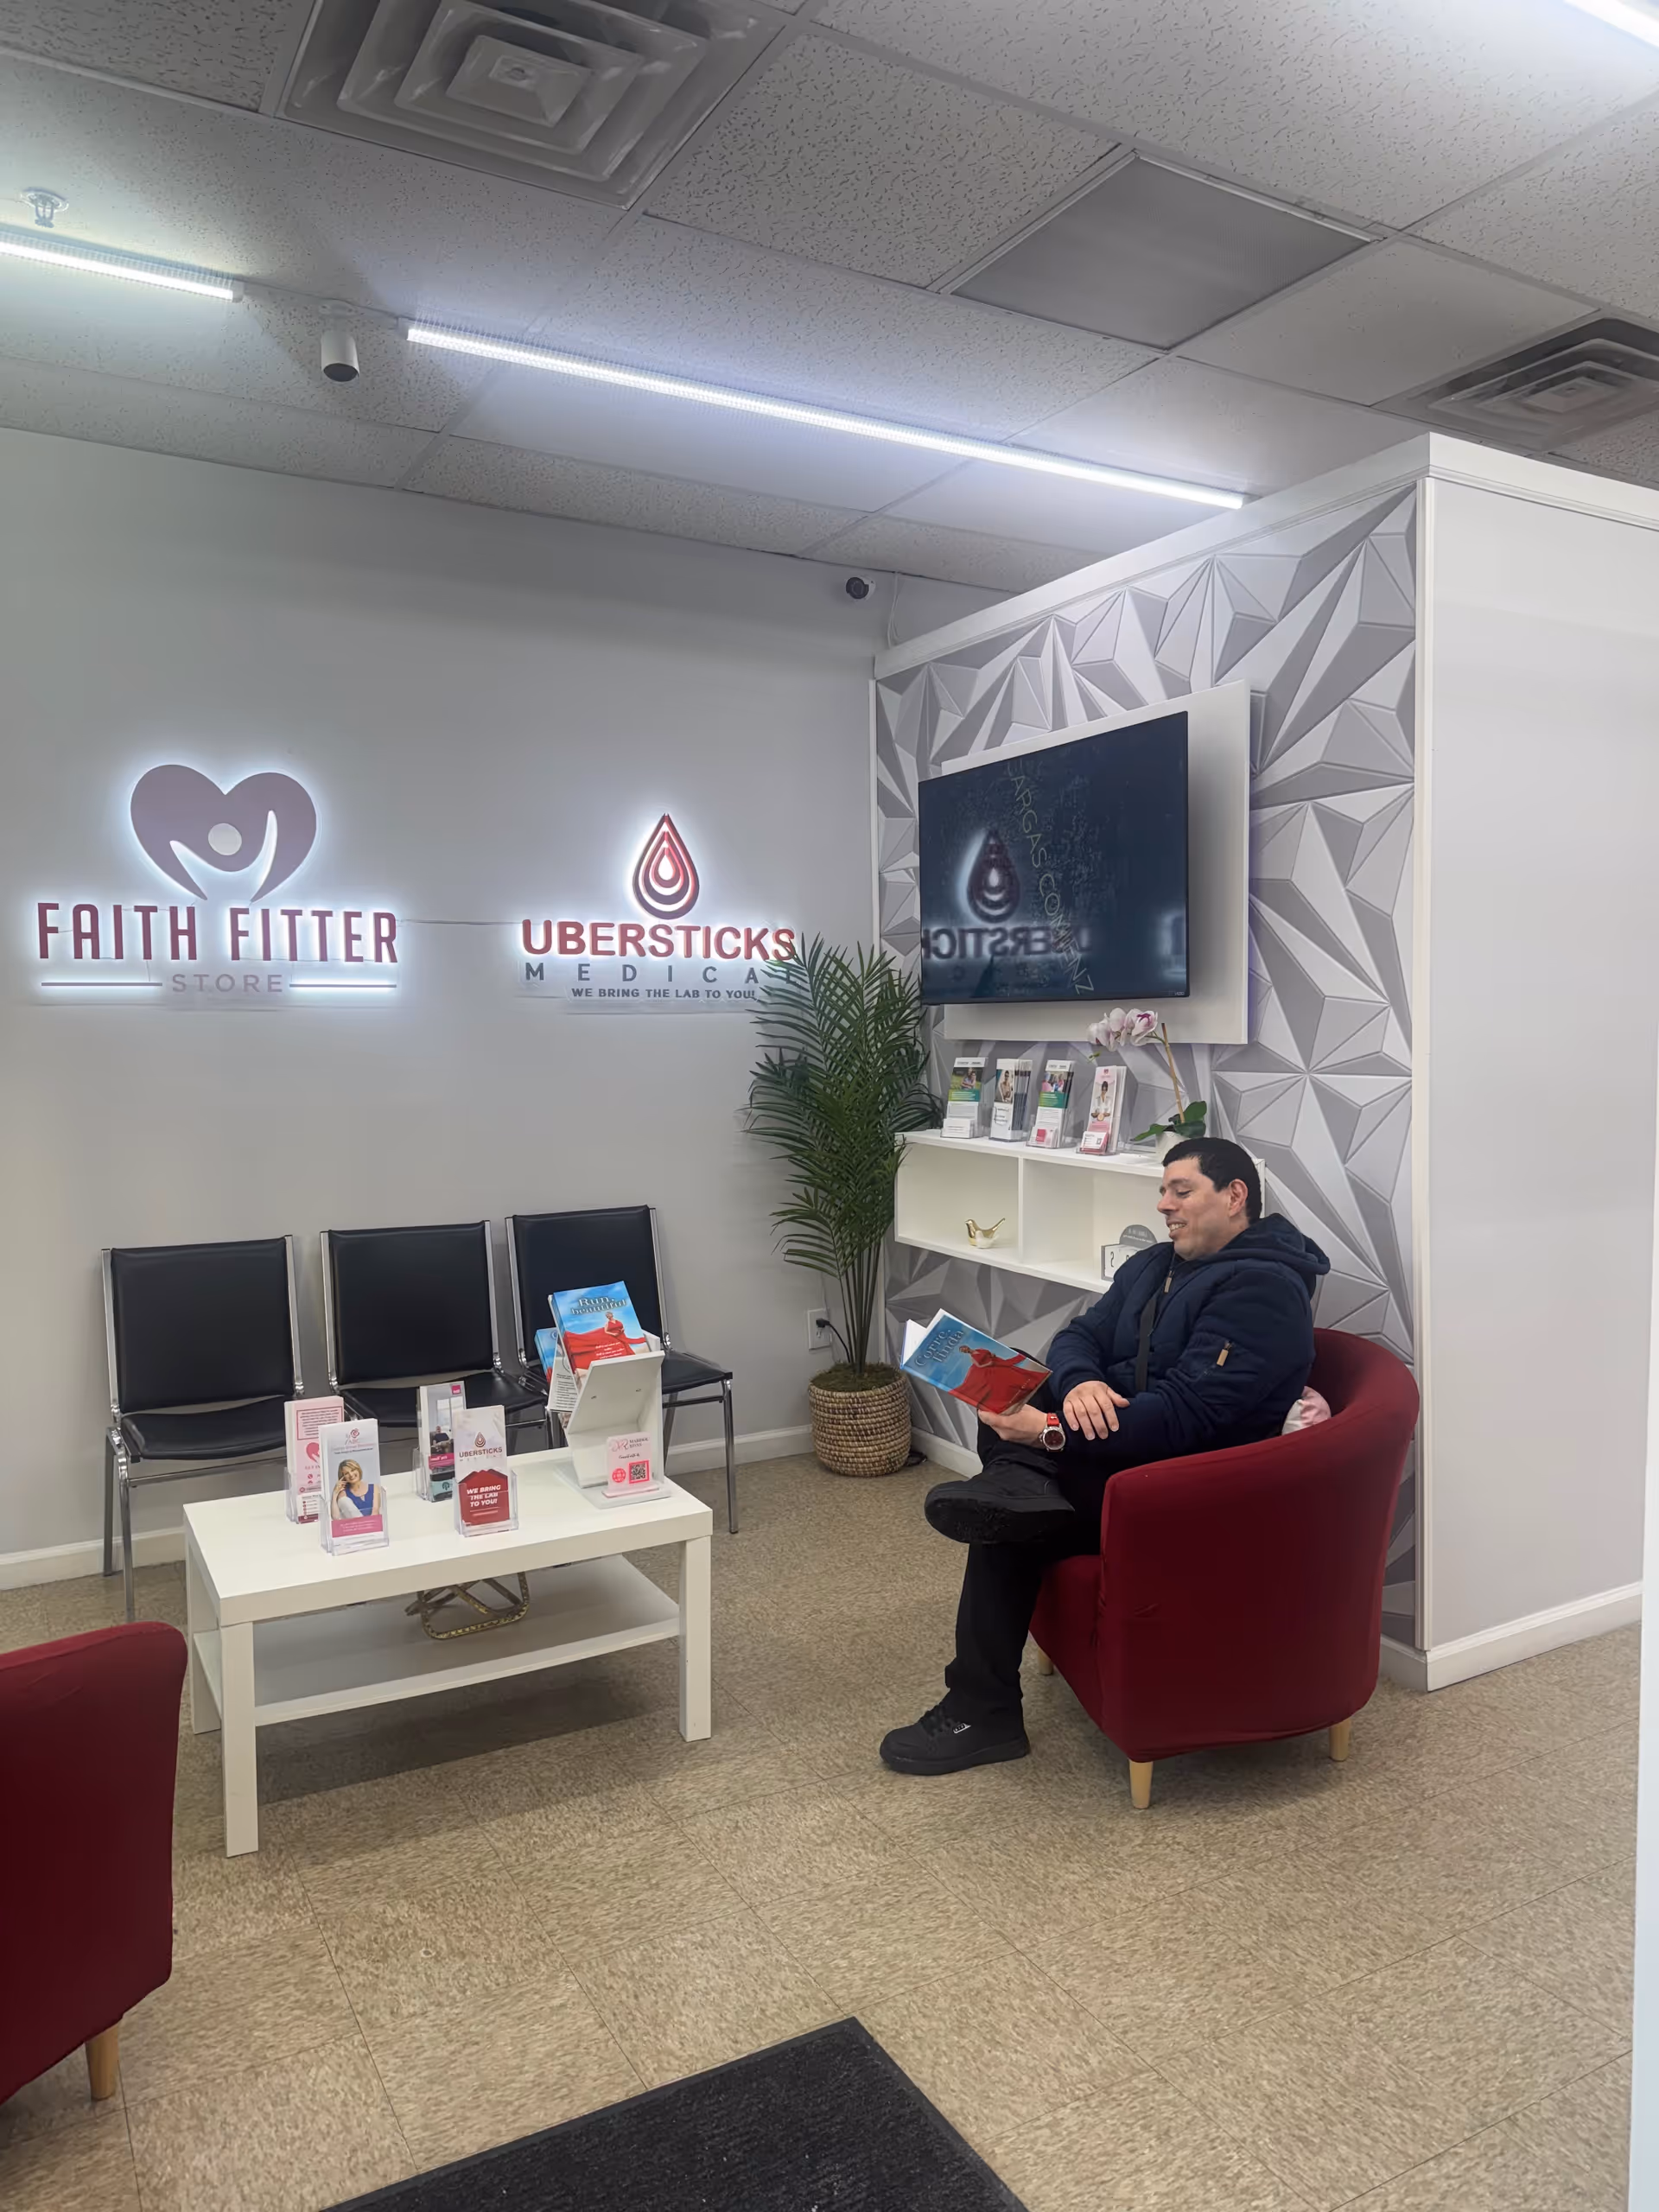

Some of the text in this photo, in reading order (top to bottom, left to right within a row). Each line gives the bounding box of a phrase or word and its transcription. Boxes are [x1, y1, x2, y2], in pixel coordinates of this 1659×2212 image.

[37, 902, 397, 963] FAITH FITTER
[522, 918, 797, 961] UBERSTICKS
[172, 974, 283, 993] STORE
[571, 988, 594, 997] WE
[598, 988, 640, 998] BRING
[645, 988, 670, 998] THE
[675, 989, 700, 999] LAB
[705, 989, 721, 999] TO
[932, 1331, 964, 1363] linda
[459, 1446, 503, 1459] UBERSTICKS
[479, 1484, 501, 1493] BRING
[470, 1497, 498, 1508] TO YOU!
